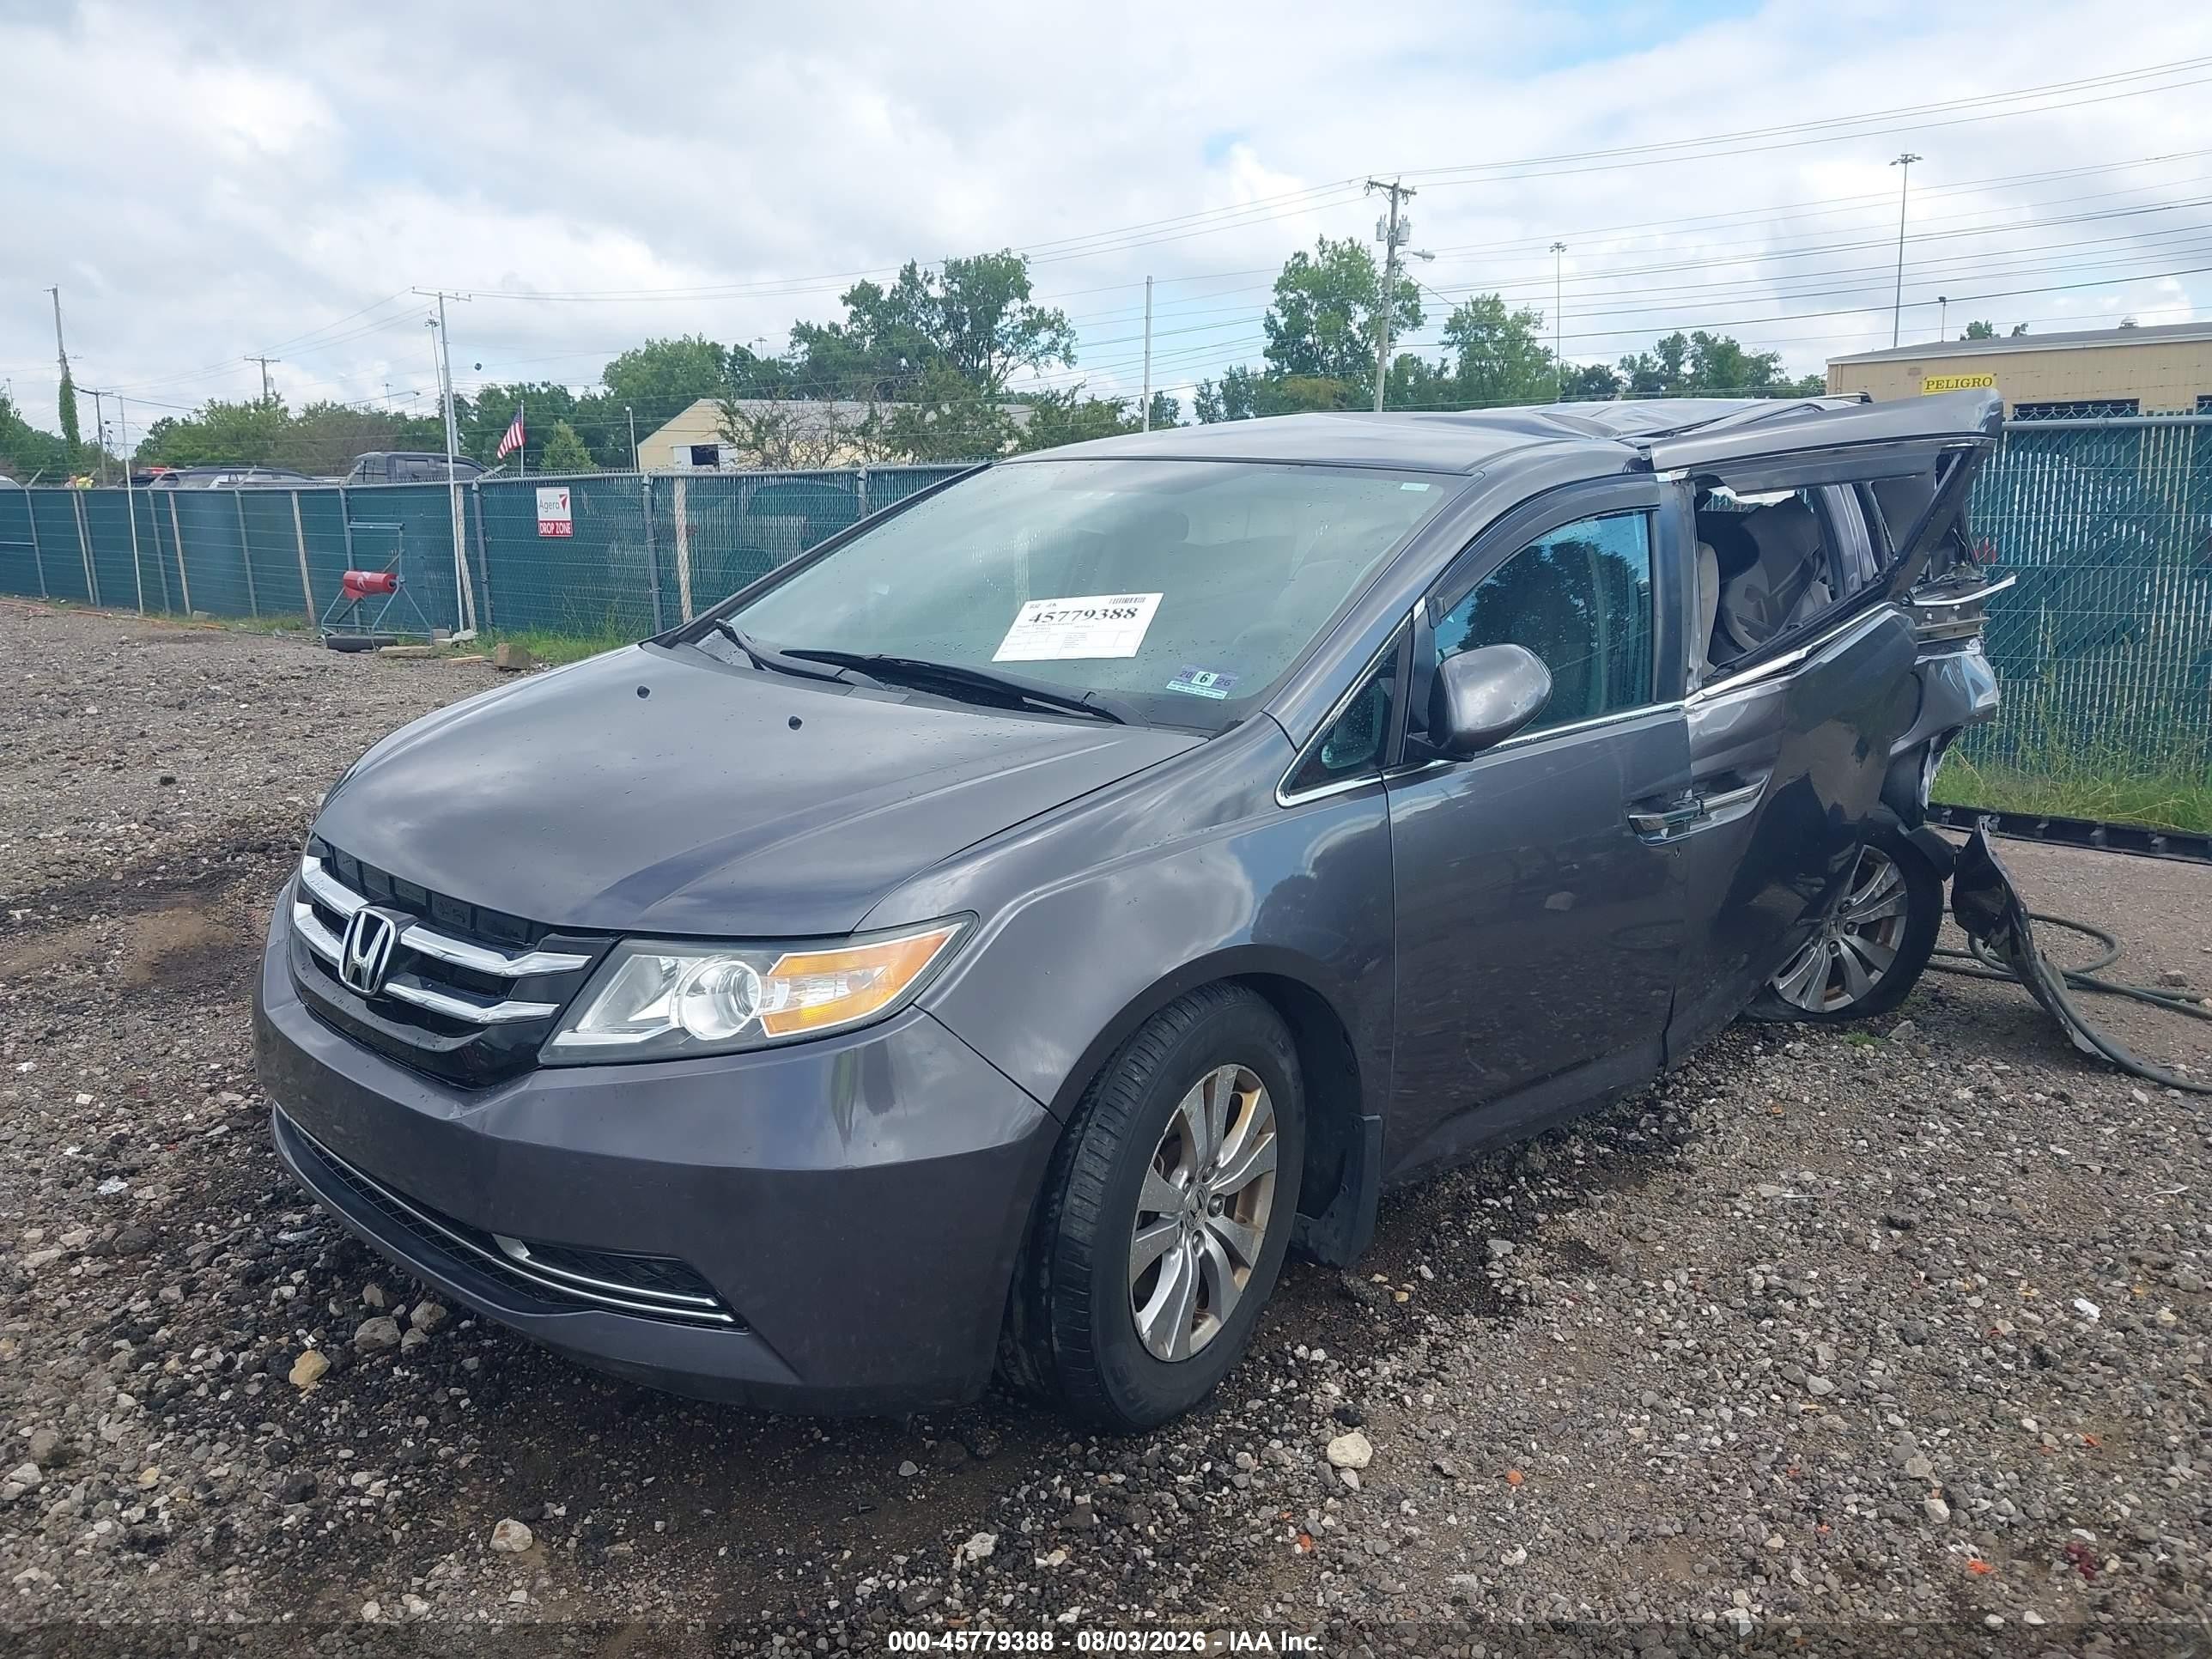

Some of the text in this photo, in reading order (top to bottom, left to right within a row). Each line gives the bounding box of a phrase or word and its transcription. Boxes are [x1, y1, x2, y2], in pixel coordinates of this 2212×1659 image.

[1924, 377, 1993, 390] PELIGRO
[539, 499, 560, 513] Agero
[539, 522, 571, 534] DROP ZONE
[1029, 607, 1139, 623] 45779388
[1180, 671, 1231, 687] 20 6 26
